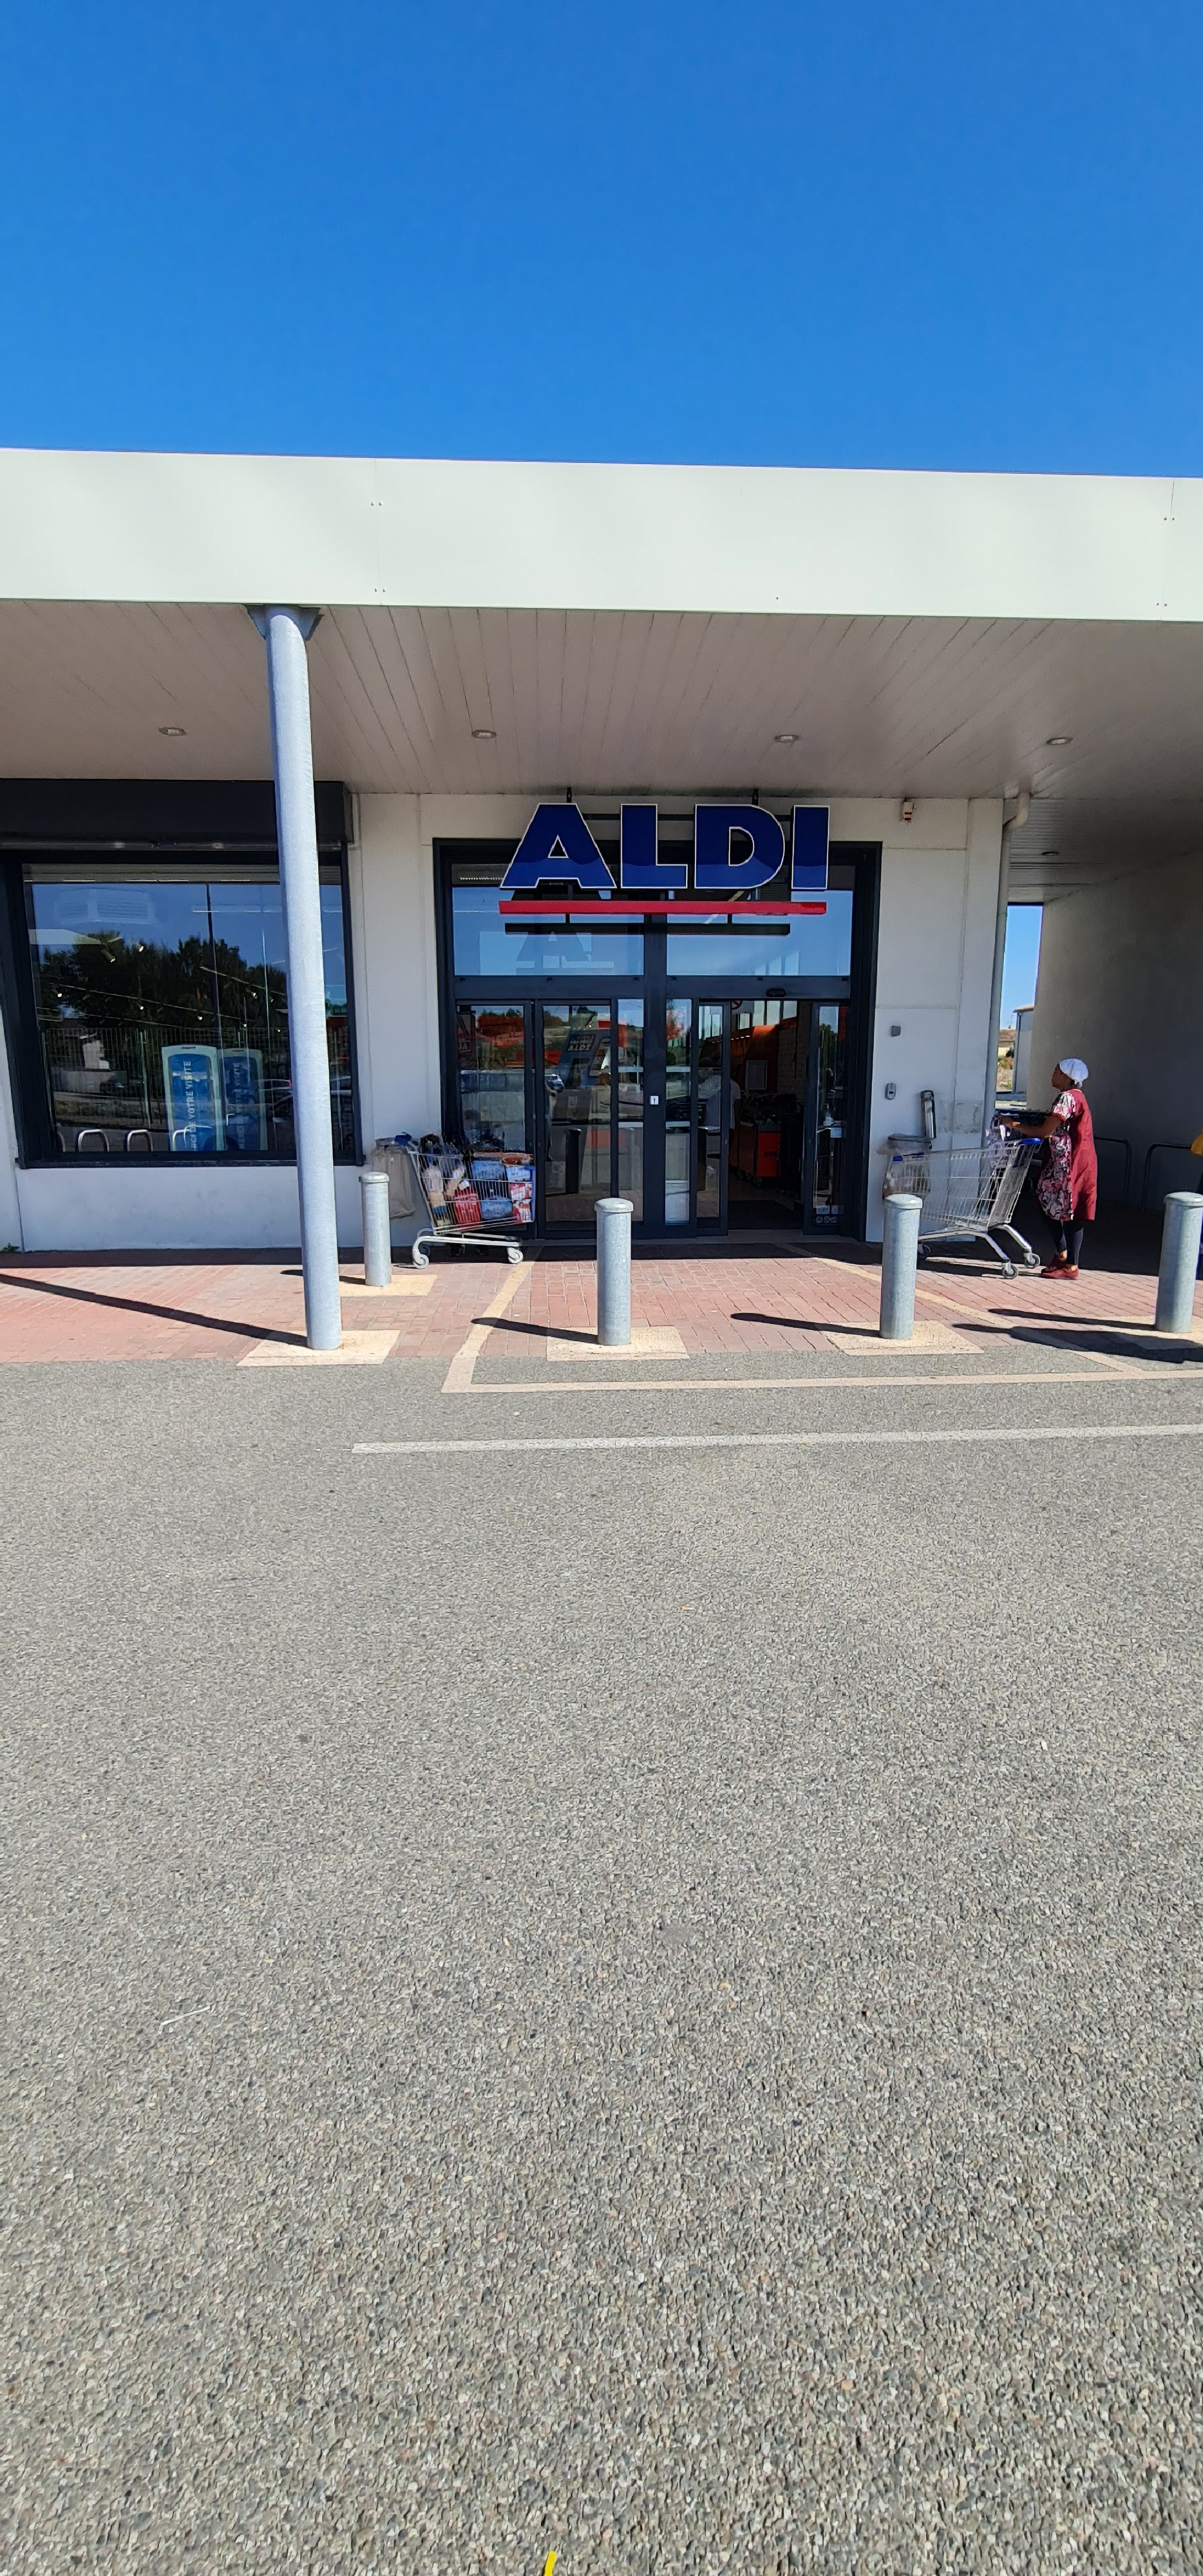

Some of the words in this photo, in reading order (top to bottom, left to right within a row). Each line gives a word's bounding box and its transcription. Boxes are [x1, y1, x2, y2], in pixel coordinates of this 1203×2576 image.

[500, 803, 830, 889] ALDI
[184, 1061, 193, 1089] VISITE
[185, 1091, 196, 1119] VOTRE
